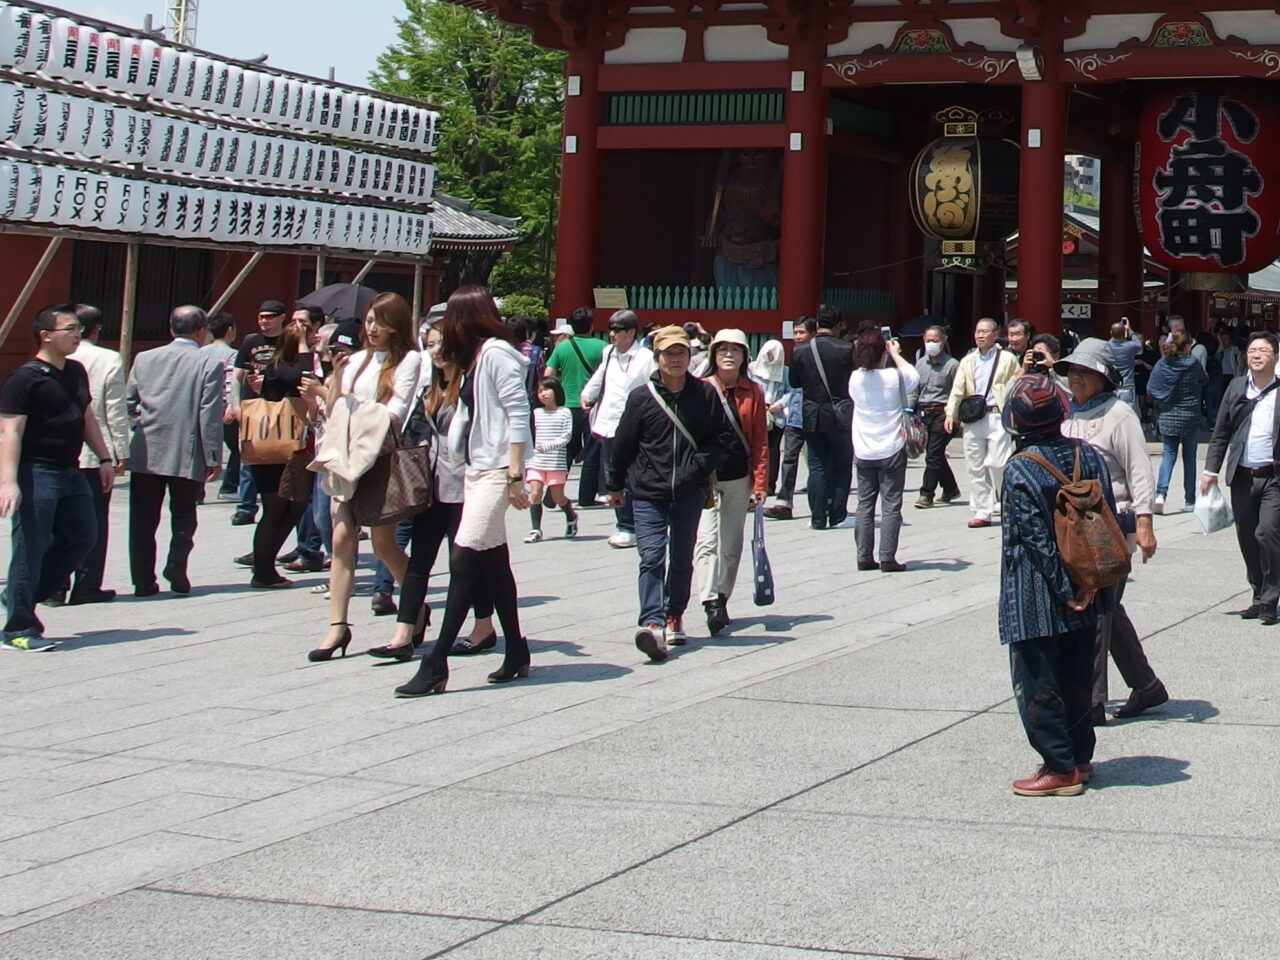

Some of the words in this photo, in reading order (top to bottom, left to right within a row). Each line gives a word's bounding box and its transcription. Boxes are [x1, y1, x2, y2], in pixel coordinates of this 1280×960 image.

[50, 175, 64, 217] ROX
[1153, 87, 1264, 267] 小舟町
[71, 177, 87, 219] ROX
[92, 181, 108, 222] ROX
[117, 184, 131, 224] ROX
[141, 186, 150, 225] ROX
